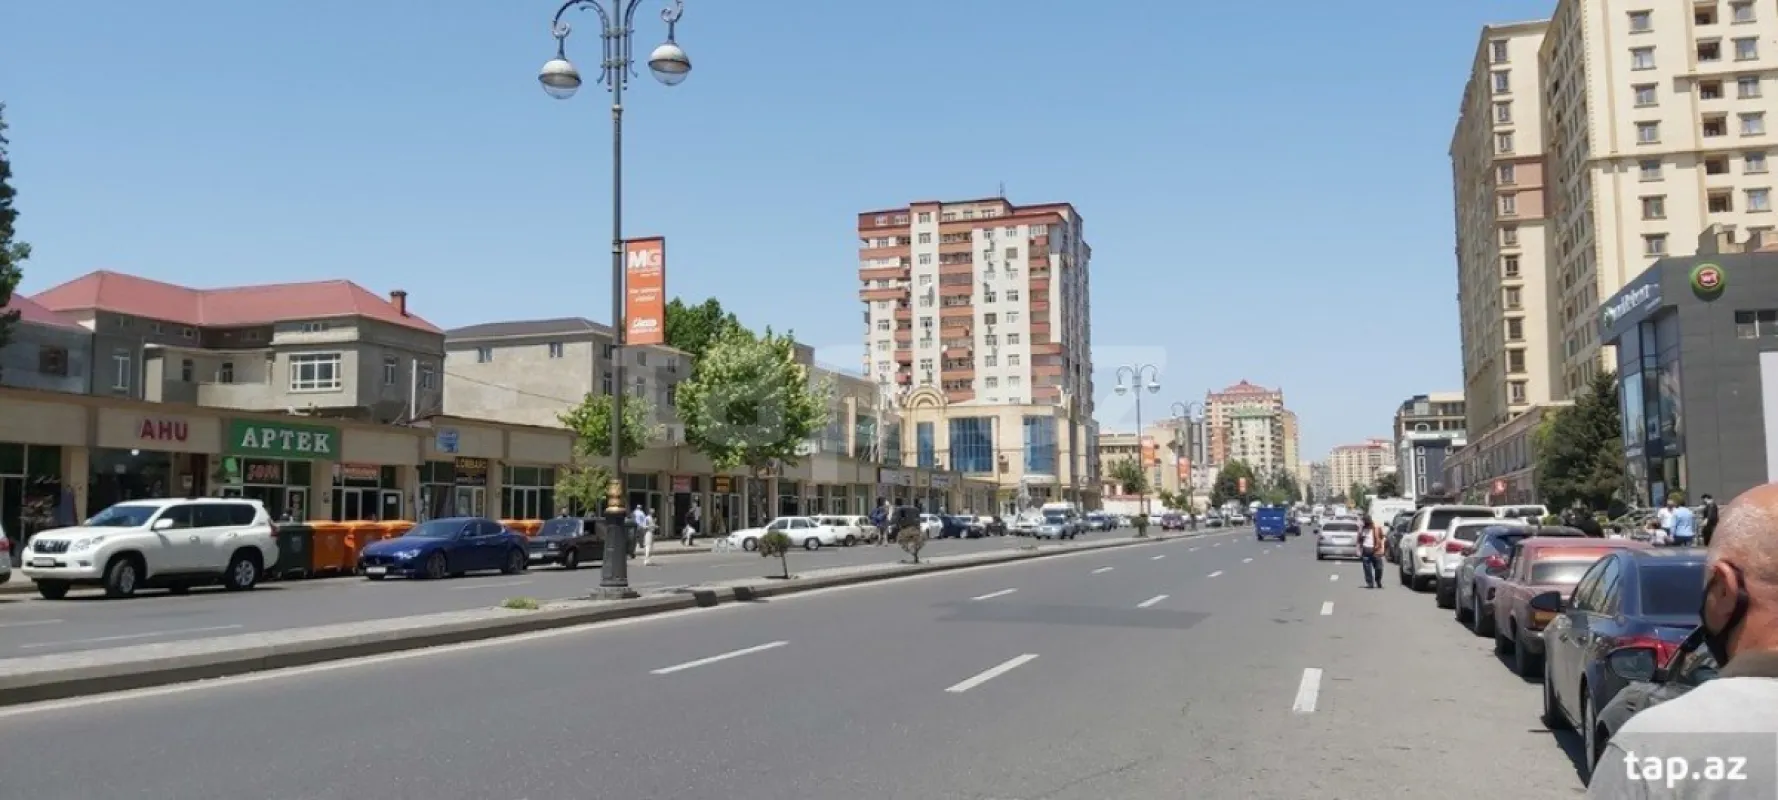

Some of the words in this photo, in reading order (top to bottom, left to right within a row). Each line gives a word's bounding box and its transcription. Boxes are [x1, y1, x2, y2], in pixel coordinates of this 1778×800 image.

[627, 249, 661, 269] MG
[140, 419, 188, 442] AHU
[241, 427, 331, 453] APTEK
